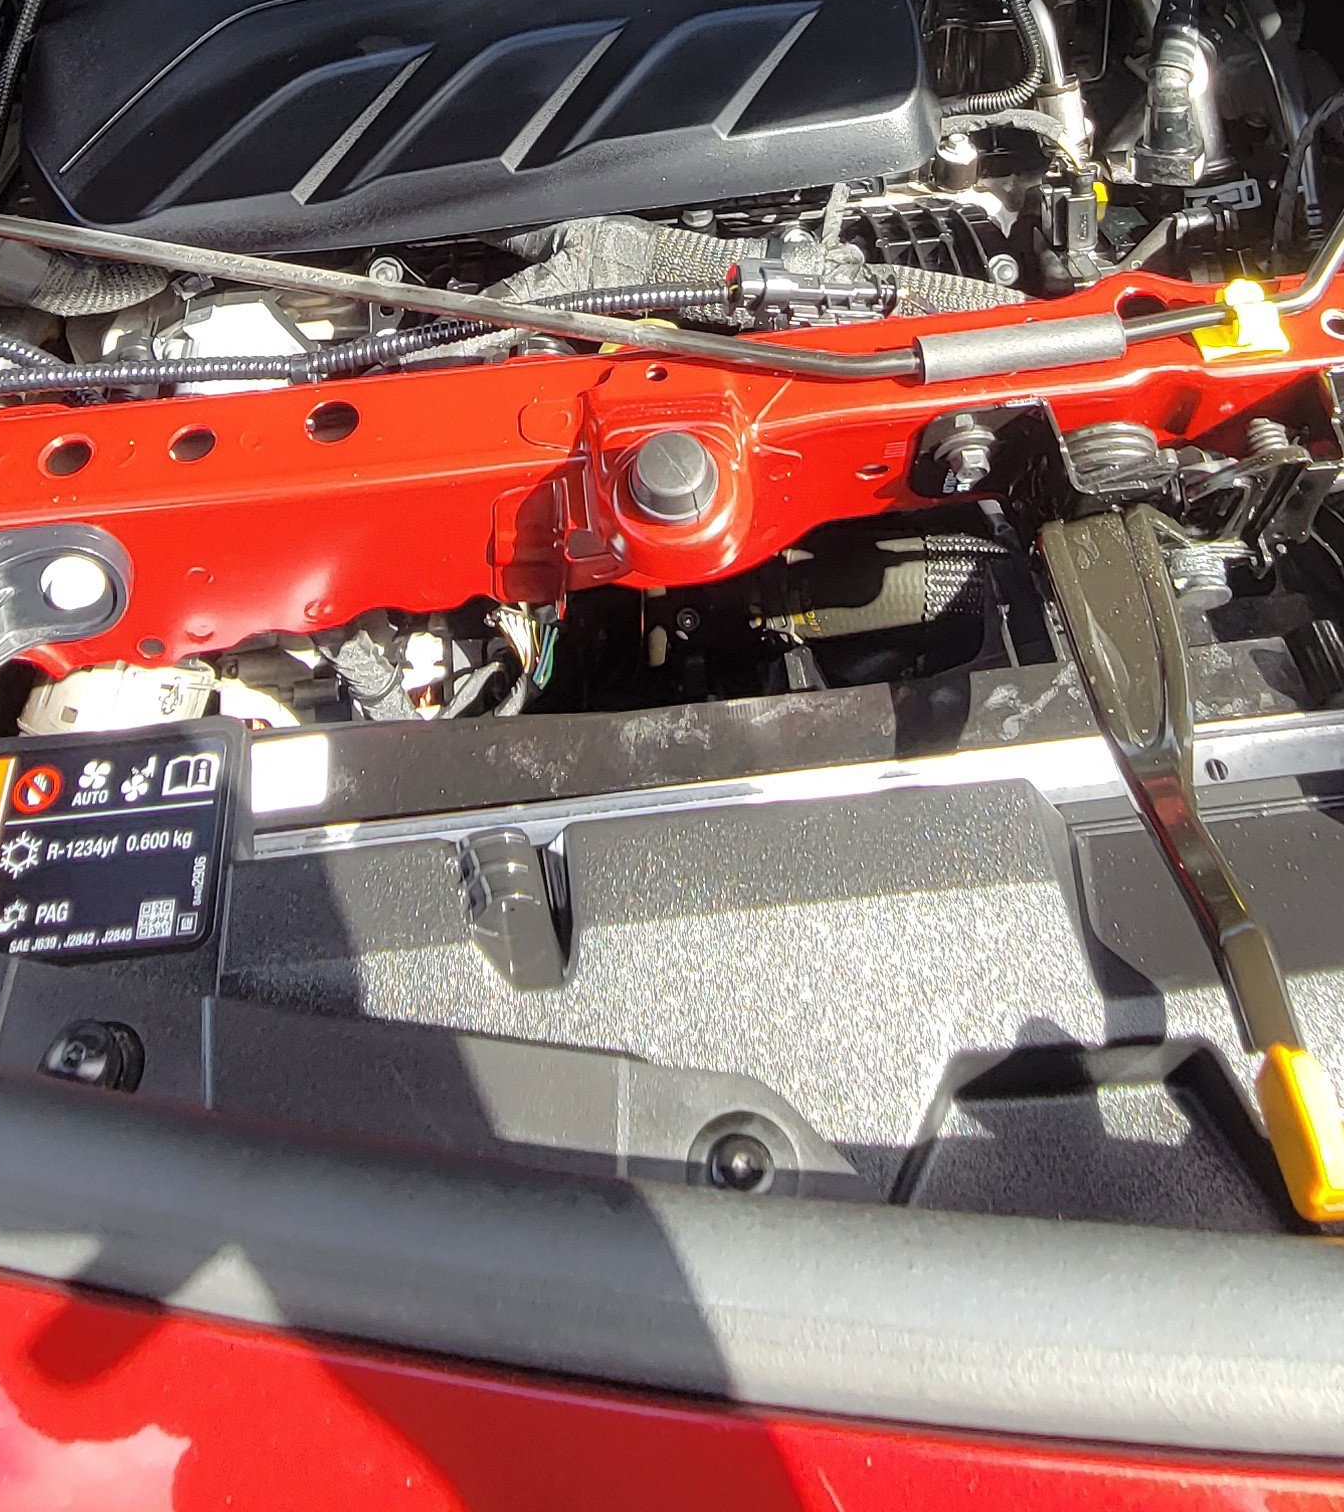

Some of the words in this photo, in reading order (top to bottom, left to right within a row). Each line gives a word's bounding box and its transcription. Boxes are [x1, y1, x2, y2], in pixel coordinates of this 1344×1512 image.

[71, 790, 109, 807] AUTO
[46, 835, 119, 861] R-1234yf
[126, 831, 169, 852] 0.600
[172, 829, 193, 849] kg
[35, 902, 70, 925] PAG
[9, 938, 30, 953] SAE
